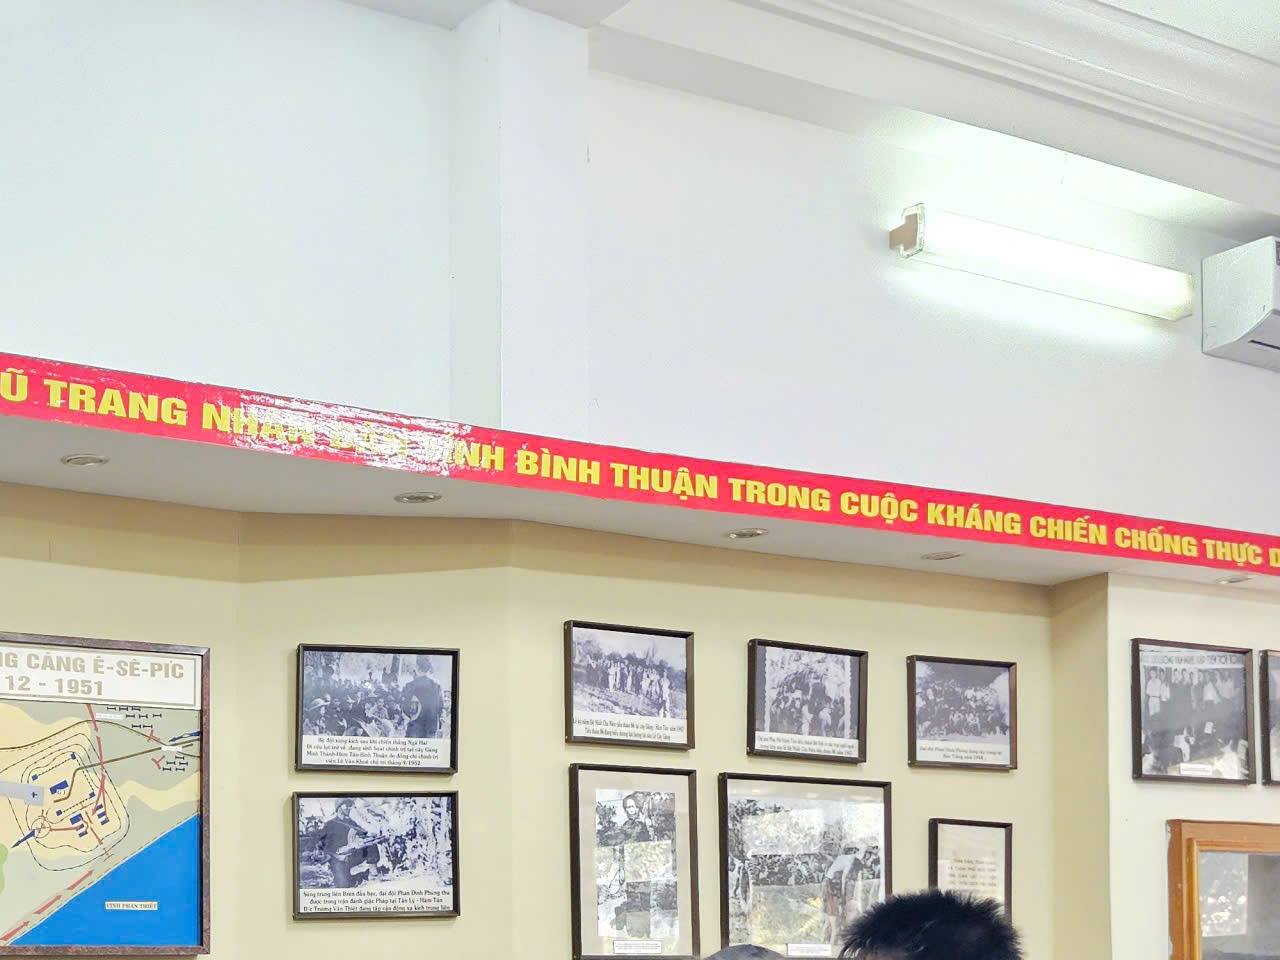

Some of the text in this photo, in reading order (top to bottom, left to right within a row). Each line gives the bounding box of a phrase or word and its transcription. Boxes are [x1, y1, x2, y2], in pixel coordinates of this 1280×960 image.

[45, 379, 187, 426] TRANG
[517, 448, 600, 485] BÌNH
[611, 461, 718, 502] THUẬN
[729, 478, 830, 511] TRONG
[840, 492, 918, 526] CUỘC
[927, 501, 1021, 535] KHÁNG
[1031, 512, 1107, 545] CHIẾN
[1115, 524, 1197, 557] CHỐNG
[1202, 539, 1263, 567] THỰC
[4, 674, 31, 692] 12
[54, 677, 103, 696] 1951
